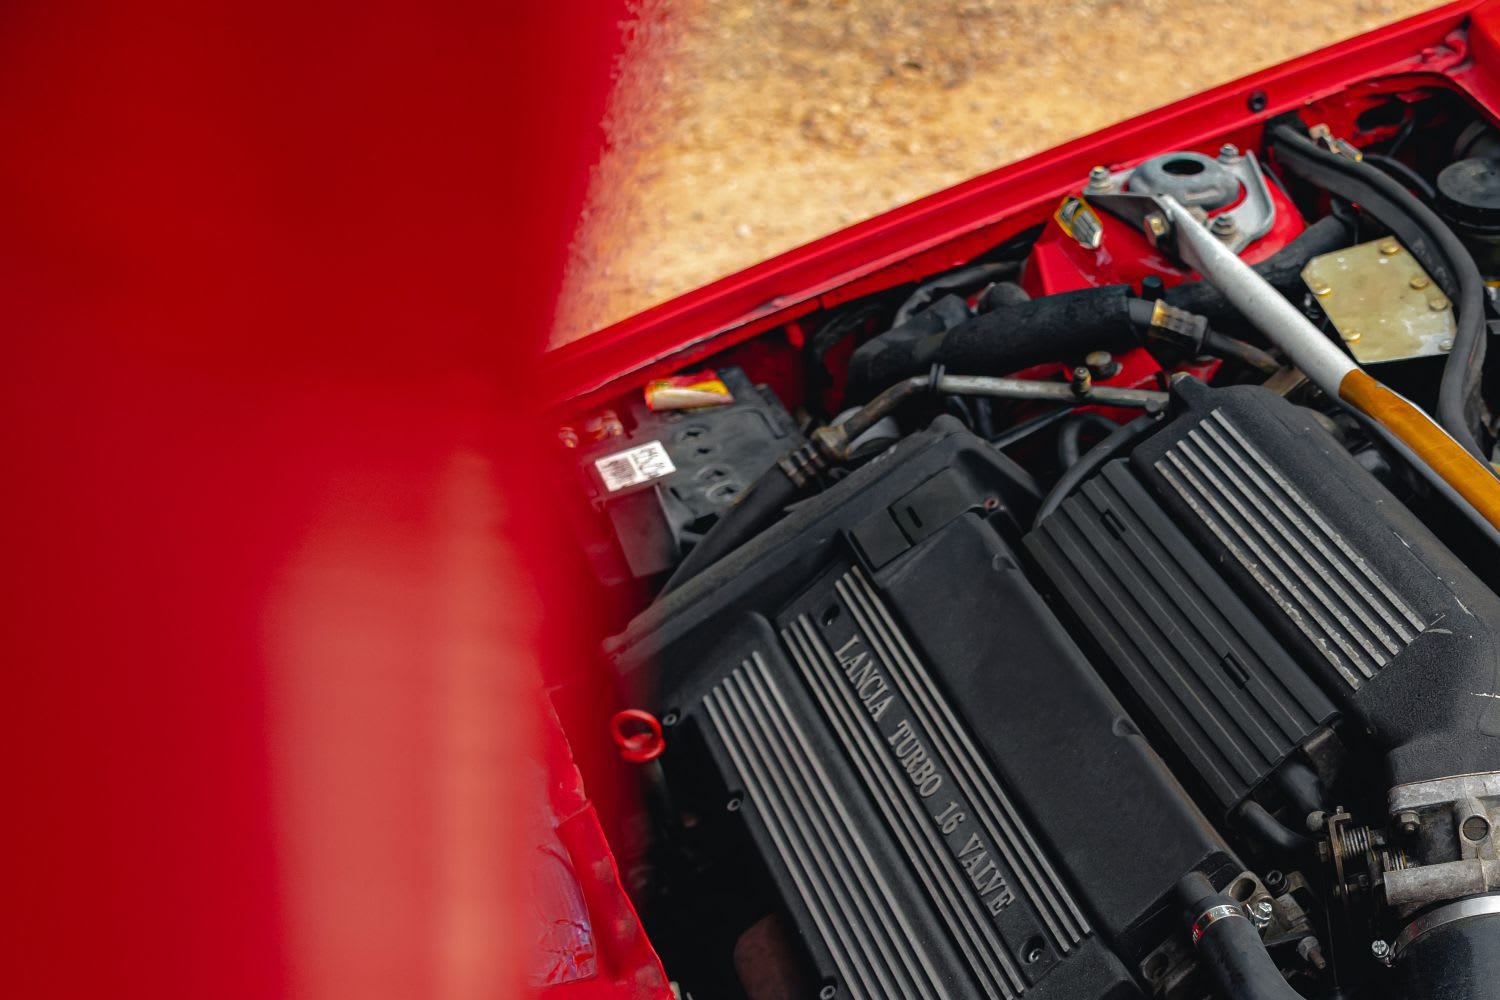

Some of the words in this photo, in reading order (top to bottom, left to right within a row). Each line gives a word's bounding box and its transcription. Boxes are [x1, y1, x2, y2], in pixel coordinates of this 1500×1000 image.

[834, 635, 894, 722] LANCIA
[888, 720, 942, 797] TURBO
[934, 802, 965, 834] 16
[958, 833, 1016, 916] VALVE
